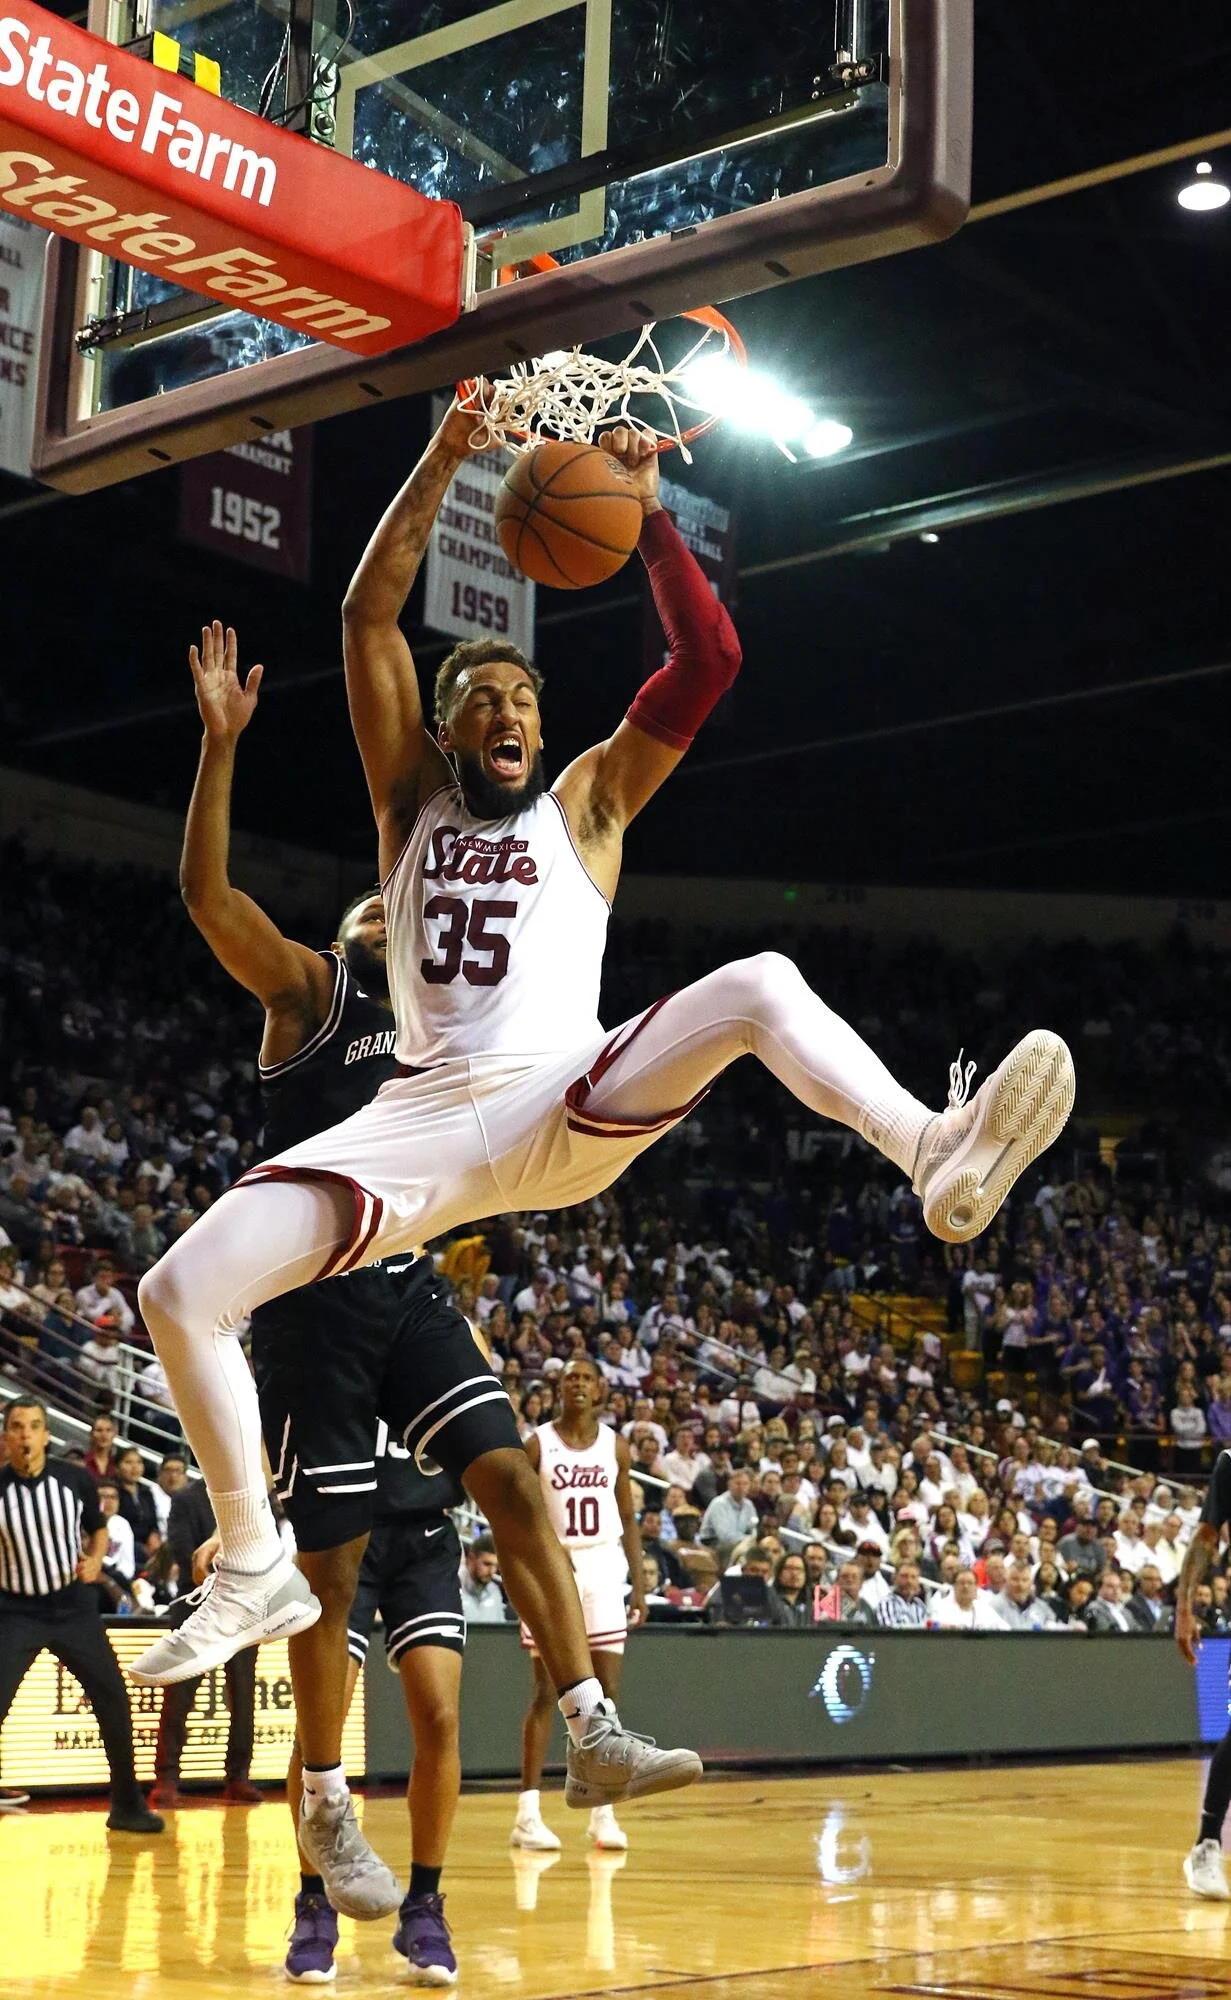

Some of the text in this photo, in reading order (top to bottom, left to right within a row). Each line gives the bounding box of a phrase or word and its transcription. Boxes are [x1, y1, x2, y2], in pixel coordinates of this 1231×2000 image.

[210, 487, 280, 550] 1952
[453, 581, 509, 633] 1959
[422, 825, 539, 886] State
[420, 895, 518, 987] 35
[344, 1030, 398, 1066] GRAN
[551, 1463, 609, 1490] State
[565, 1496, 600, 1537] 10
